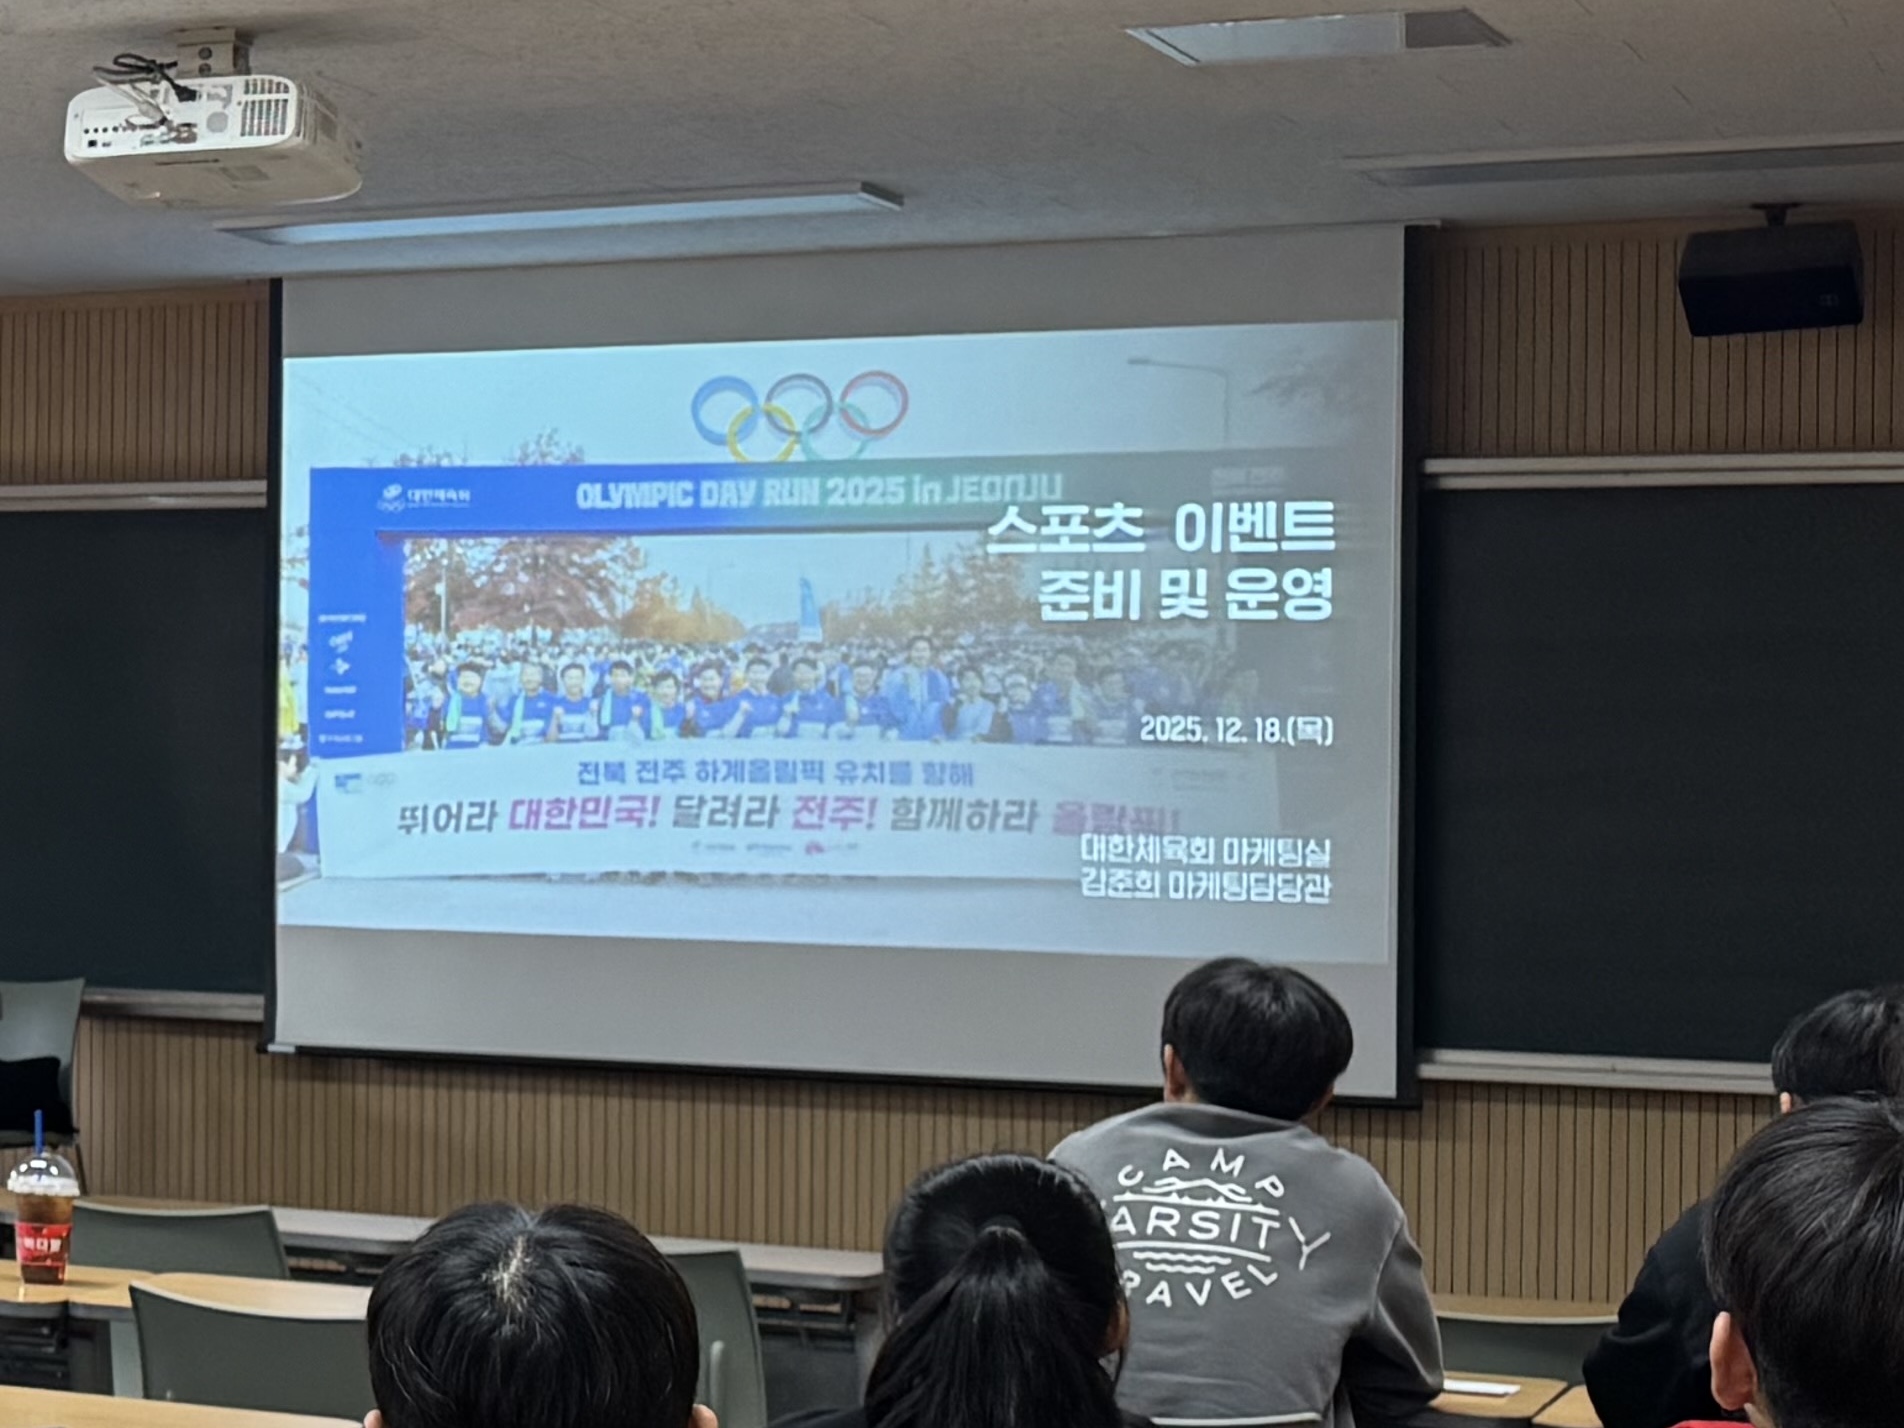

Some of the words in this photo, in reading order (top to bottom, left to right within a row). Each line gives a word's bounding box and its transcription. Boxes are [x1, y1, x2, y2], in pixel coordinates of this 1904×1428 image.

[577, 480, 694, 509] OLYMPIC
[700, 479, 757, 508] DAY
[763, 477, 821, 506] RUN
[827, 474, 907, 506] 2025
[986, 502, 1147, 554] 스포츠
[1175, 500, 1337, 554] 이벤트
[1038, 568, 1141, 622] 준비
[1159, 568, 1209, 620] 및
[1225, 567, 1334, 622] 운영
[1140, 714, 1209, 743] 2025.
[1215, 716, 1248, 744] 12.
[636, 759, 687, 784] 전주
[397, 799, 499, 835] 뛰어라
[508, 794, 662, 831] 대한민국!
[673, 794, 781, 829] 달려라
[792, 794, 879, 831] 전주!
[890, 796, 1041, 834] 함께하라
[1080, 832, 1216, 866] 대한체육회
[1222, 836, 1332, 869] 마케팅실
[1117, 1147, 1286, 1199] CAMP
[1101, 1200, 1332, 1270] ARSITY
